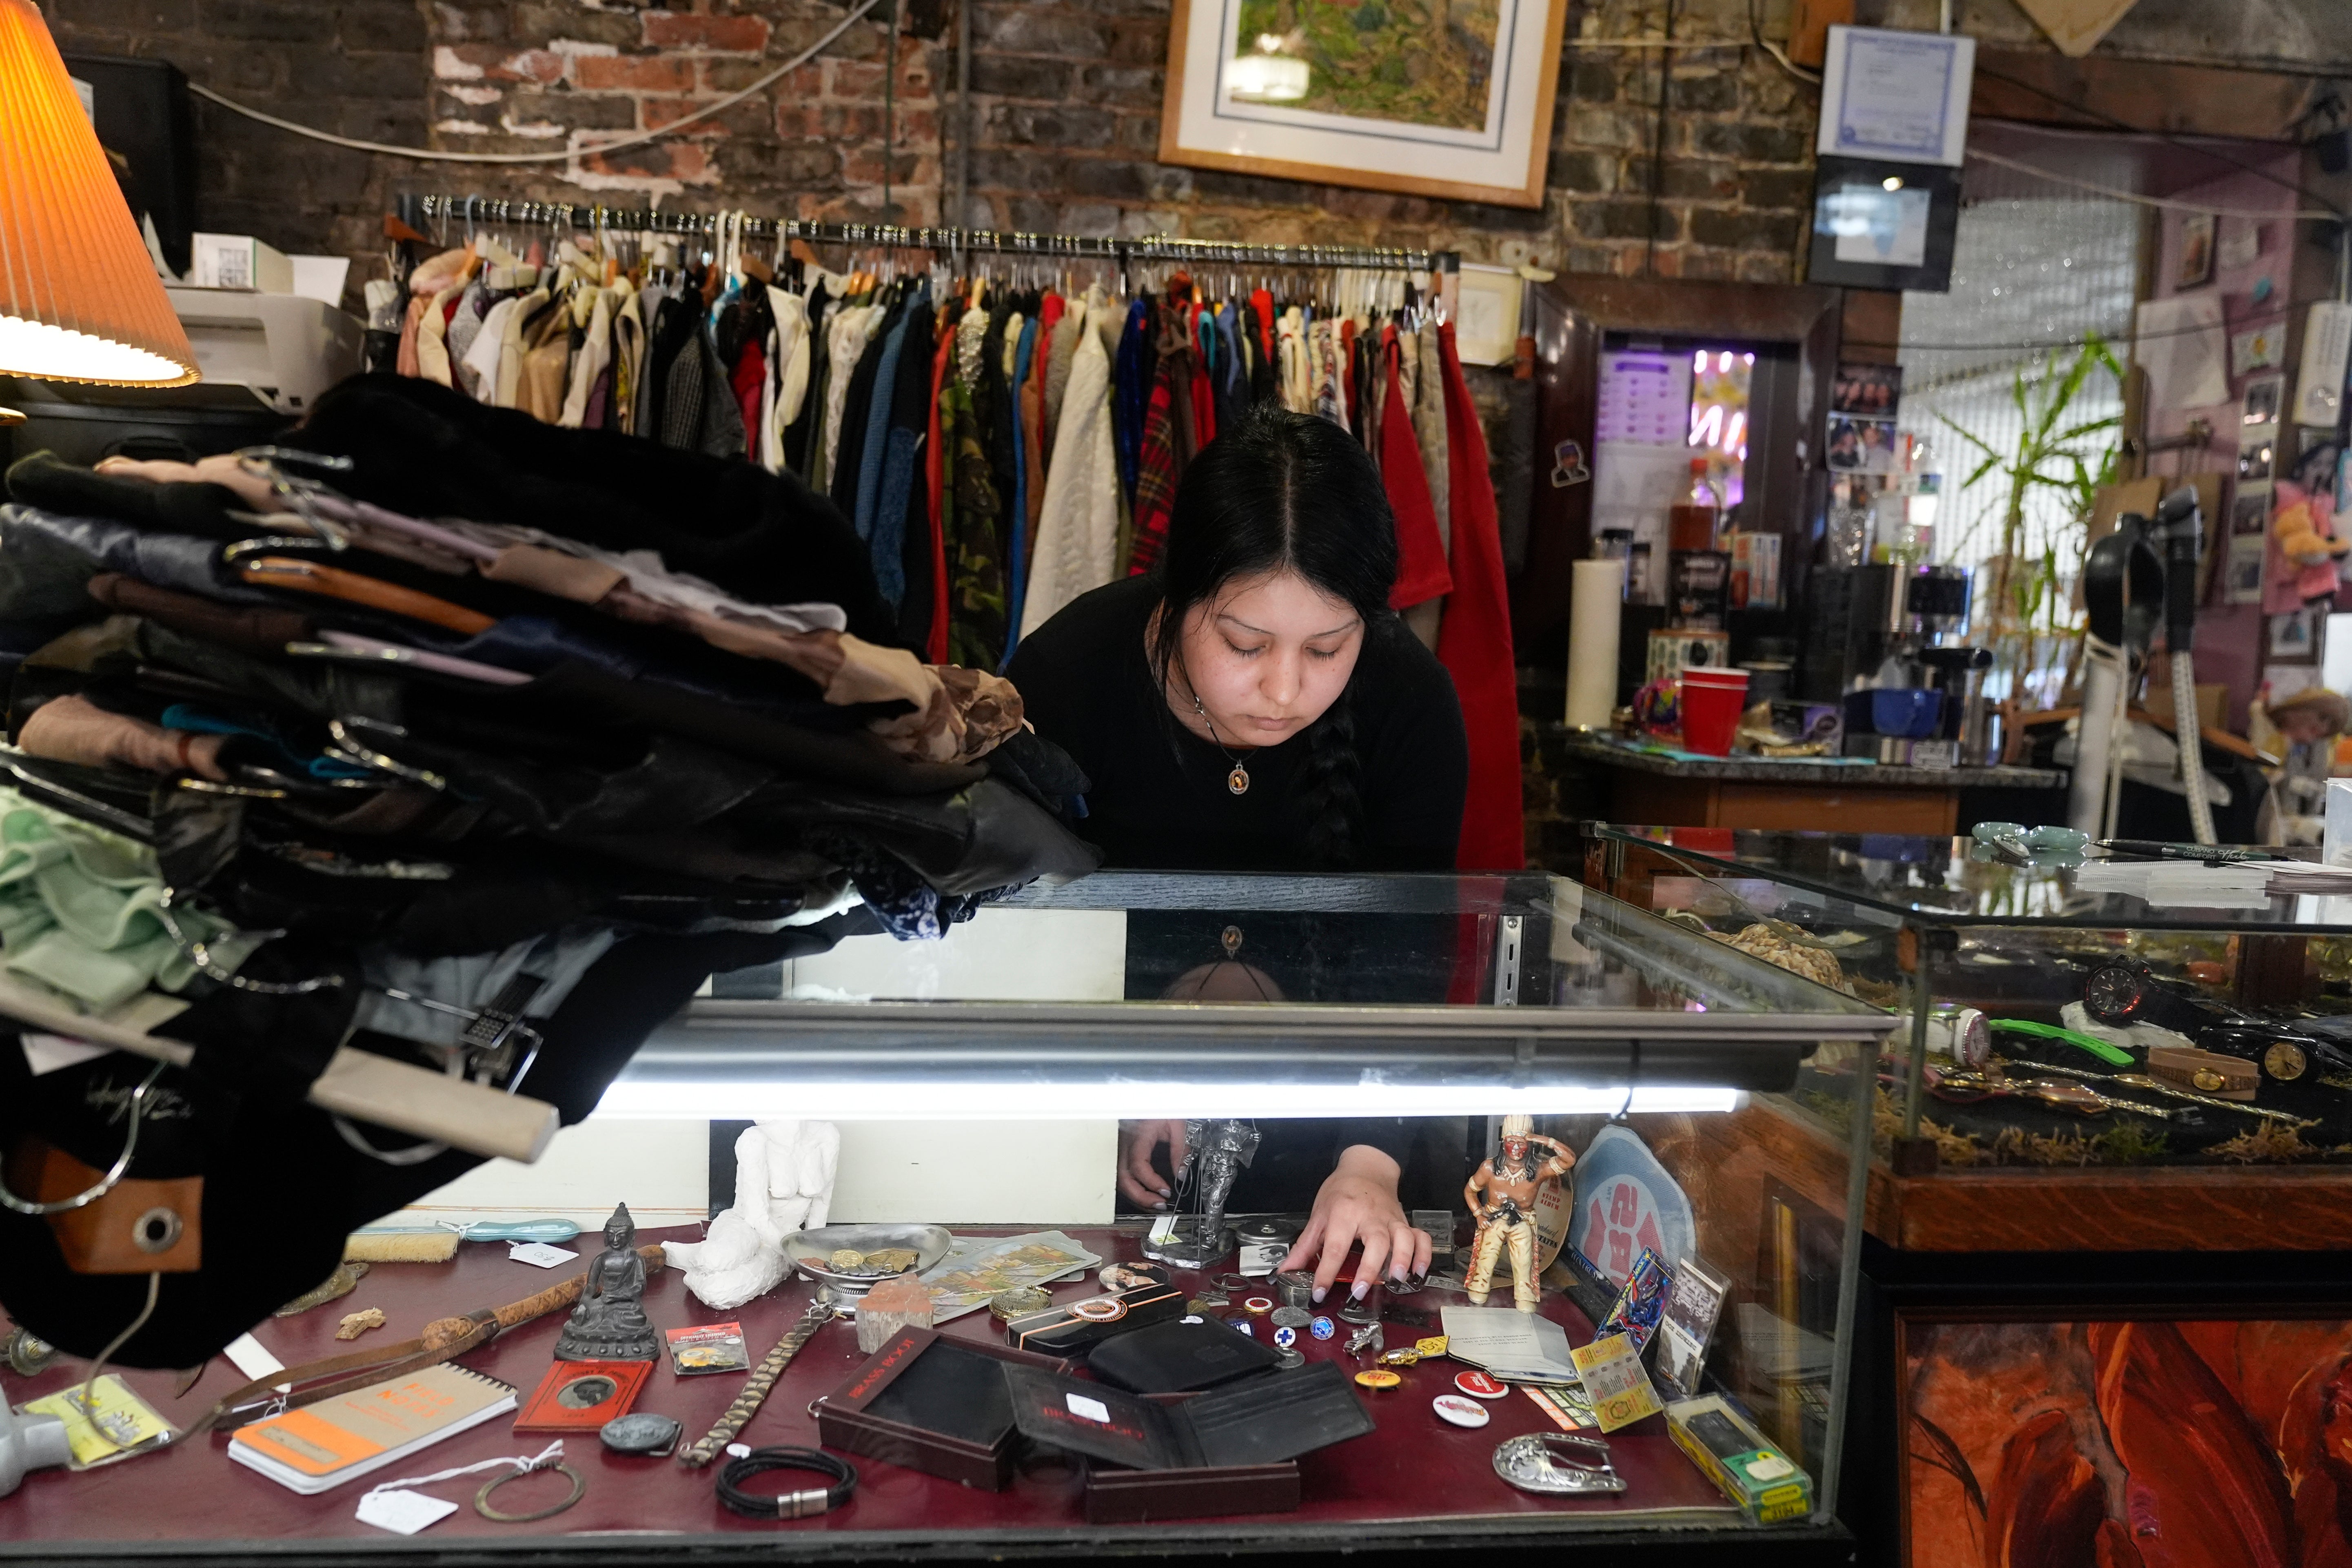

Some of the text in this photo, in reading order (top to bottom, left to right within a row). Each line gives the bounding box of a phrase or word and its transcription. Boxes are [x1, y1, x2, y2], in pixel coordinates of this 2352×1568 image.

[2183, 851, 2217, 860] COMFORT
[2186, 846, 2214, 854] CUBANO
[1542, 1192, 1561, 1203] STAMP
[1540, 1199, 1560, 1211] ALBUM
[1537, 1235, 1558, 1249] STATES
[848, 1338, 914, 1399] BRASS BOOT
[402, 1382, 455, 1406] FIELD
[376, 1390, 440, 1418] NOTES
